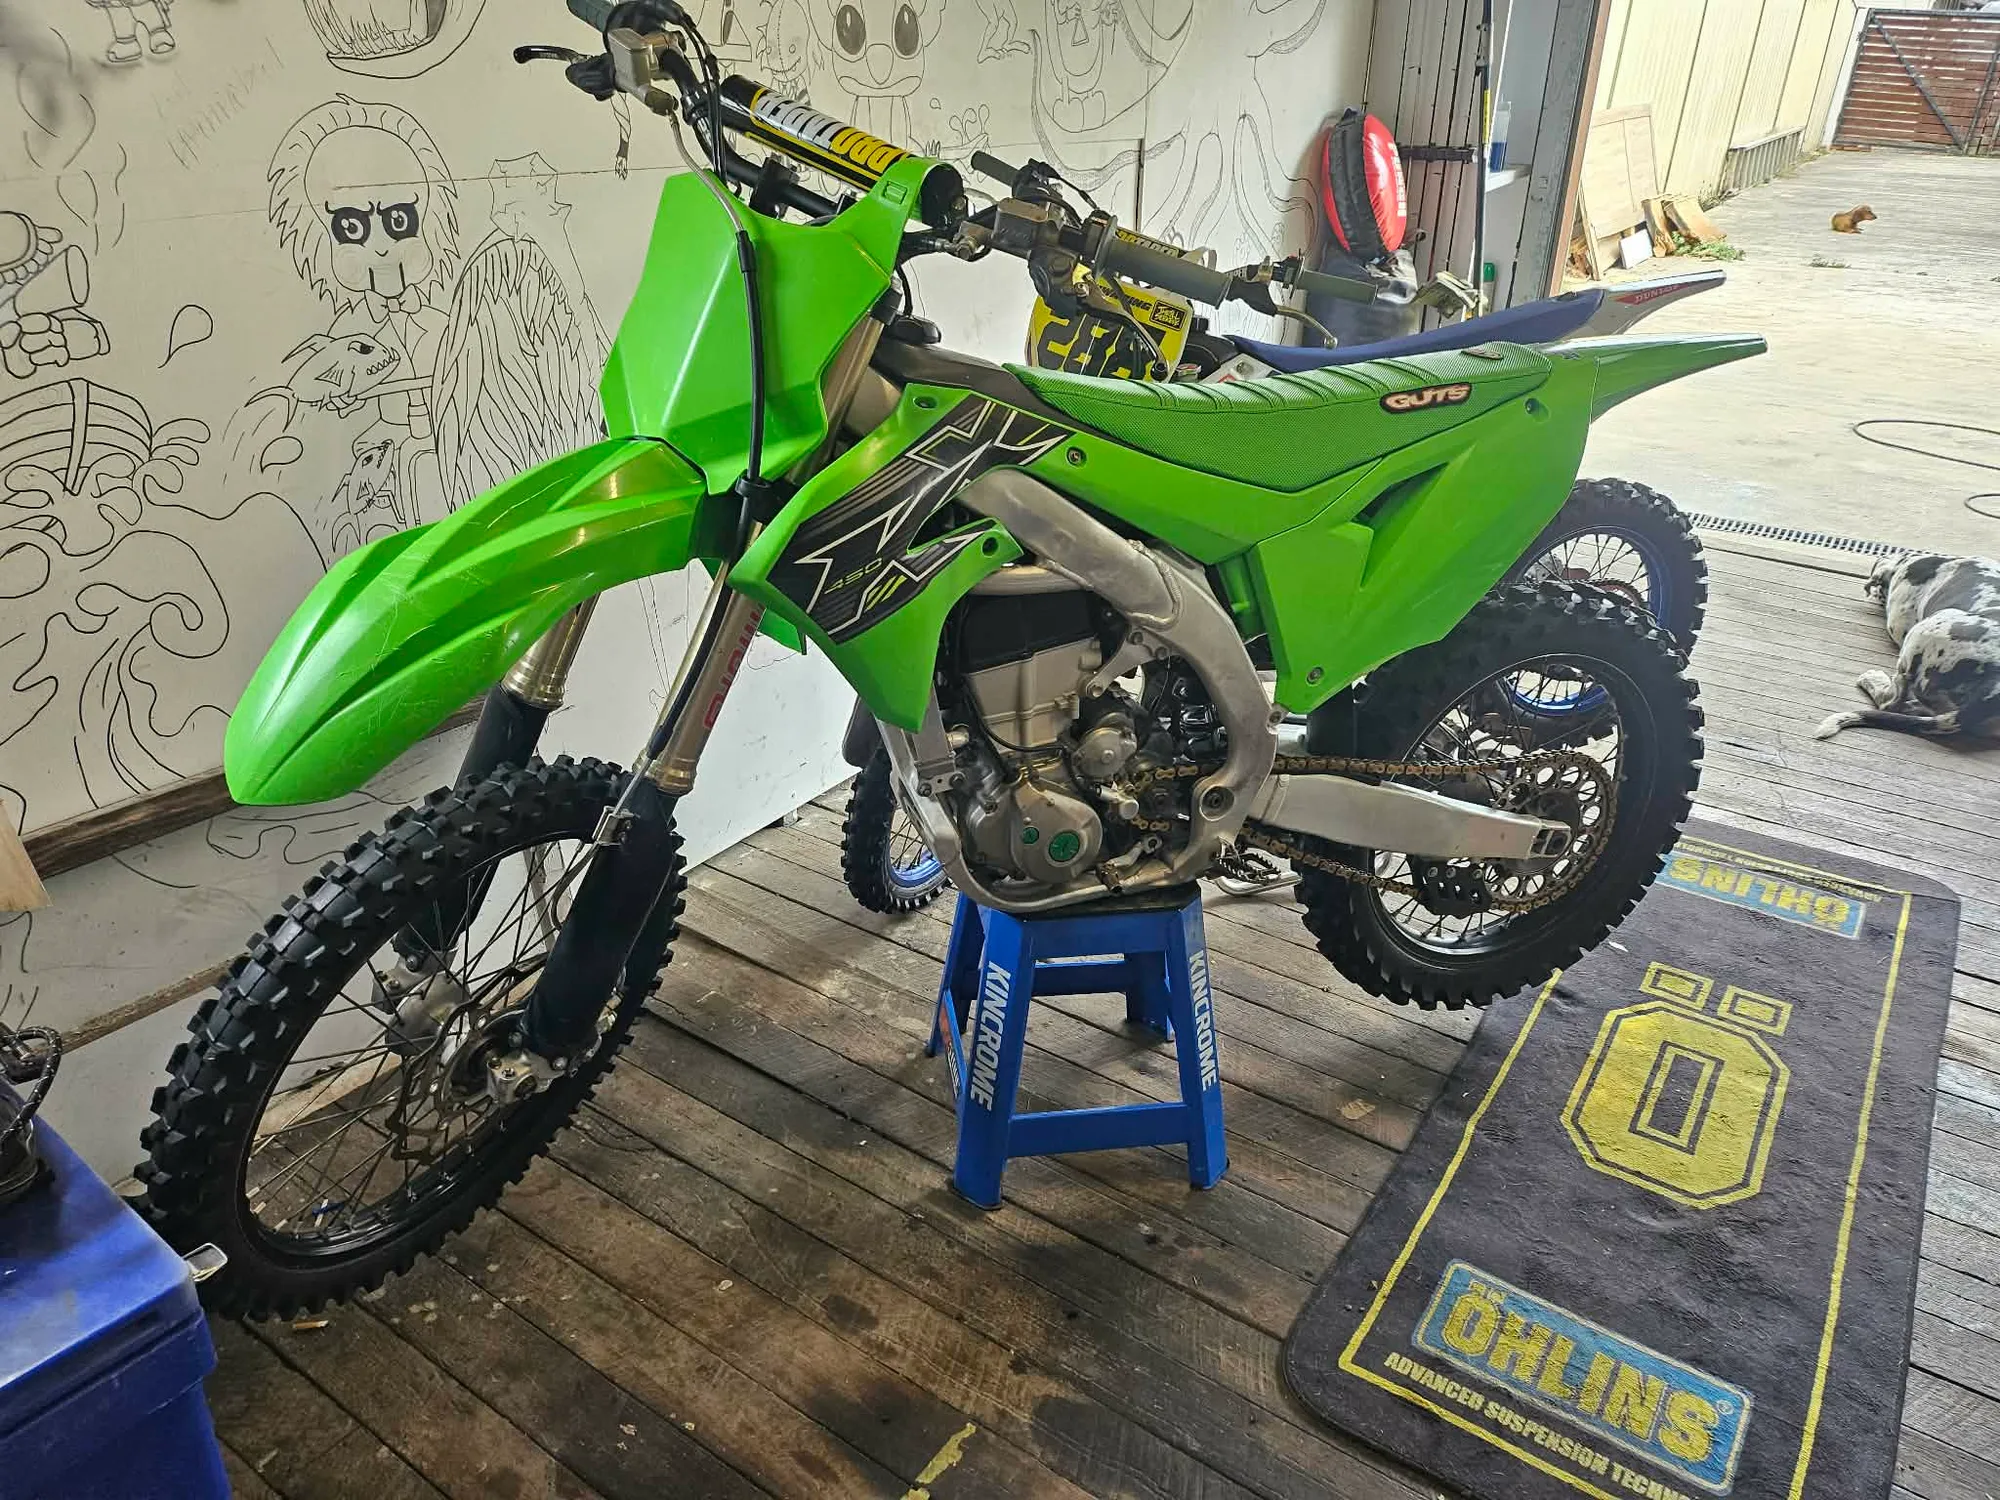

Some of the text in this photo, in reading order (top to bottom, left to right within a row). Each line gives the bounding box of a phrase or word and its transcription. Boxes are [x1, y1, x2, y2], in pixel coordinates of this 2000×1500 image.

[1384, 383, 1471, 409] GUTS
[824, 557, 882, 594] 450
[970, 960, 1011, 1112] KINCROME
[1189, 950, 1217, 1092] KINCROME
[1384, 1352, 1692, 1500] ADVANCED SUSPENSION TECHN
